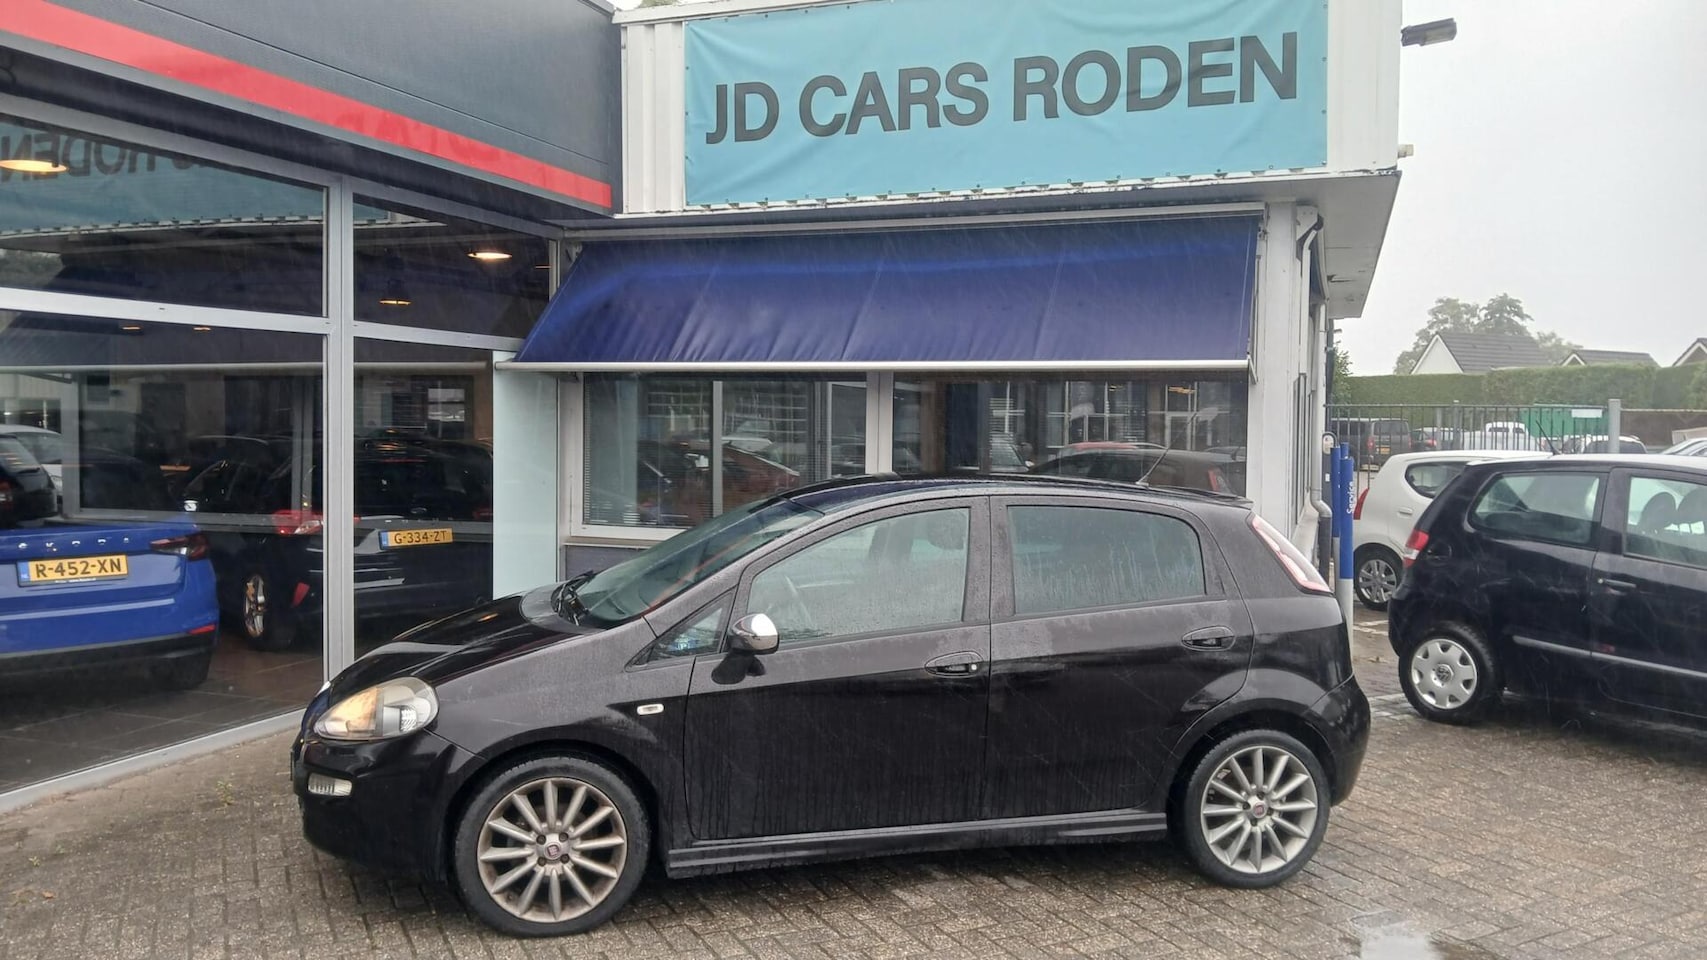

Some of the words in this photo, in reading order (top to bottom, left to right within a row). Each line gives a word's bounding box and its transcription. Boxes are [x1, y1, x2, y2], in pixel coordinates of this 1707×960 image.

[705, 81, 779, 144] JD
[798, 61, 990, 137] CARS
[1013, 31, 1298, 122] RODEN
[394, 530, 448, 545] G-334-ZT
[35, 557, 121, 579] R-452-XN
